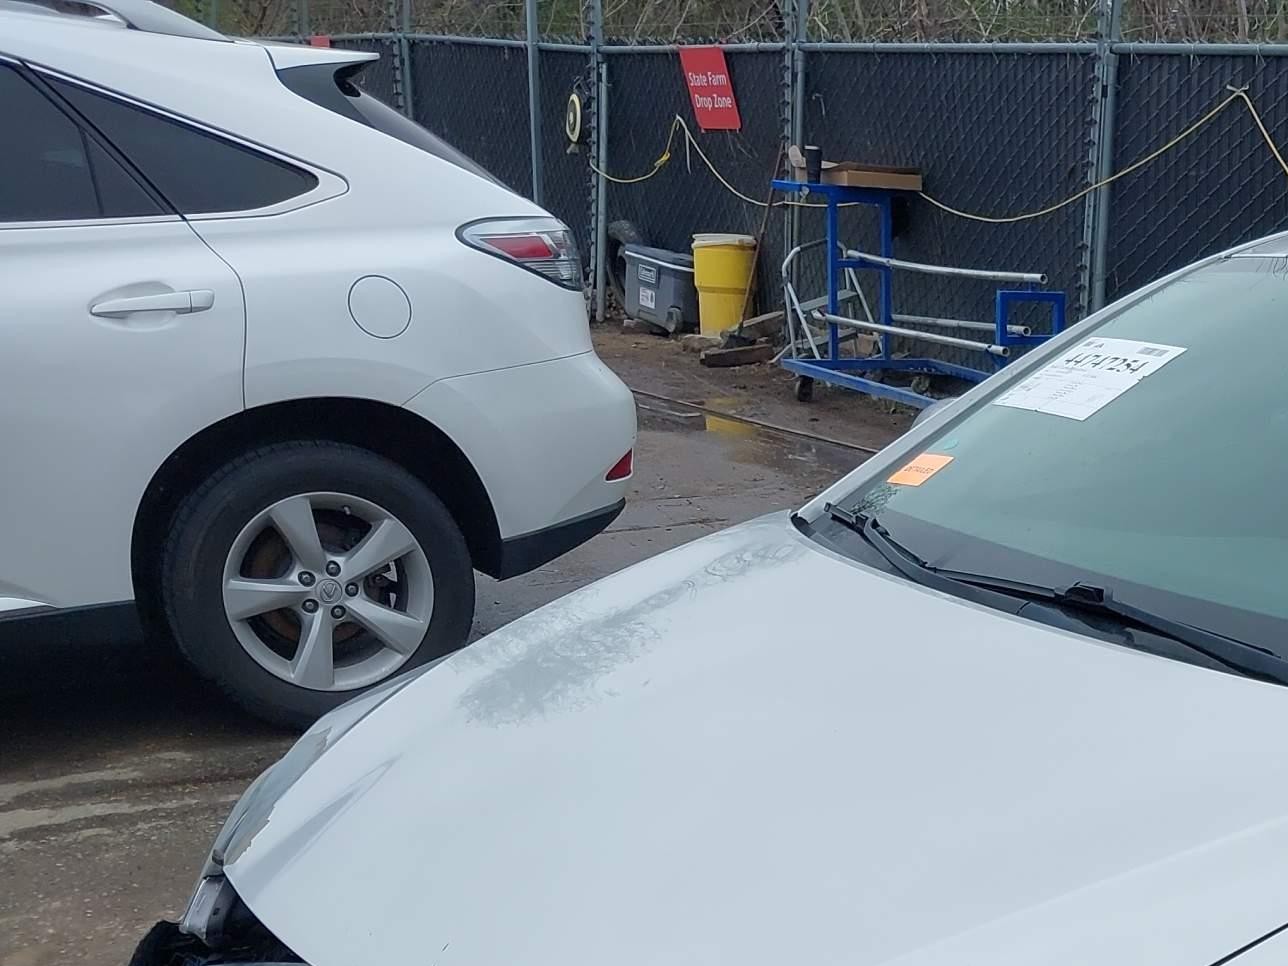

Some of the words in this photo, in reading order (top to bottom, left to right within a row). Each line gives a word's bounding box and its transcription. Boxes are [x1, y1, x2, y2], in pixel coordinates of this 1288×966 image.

[688, 72, 707, 86] State
[707, 71, 727, 86] Farm
[694, 93, 713, 111] Drop
[713, 93, 732, 108] Zone
[1064, 352, 1150, 375] 44747254
